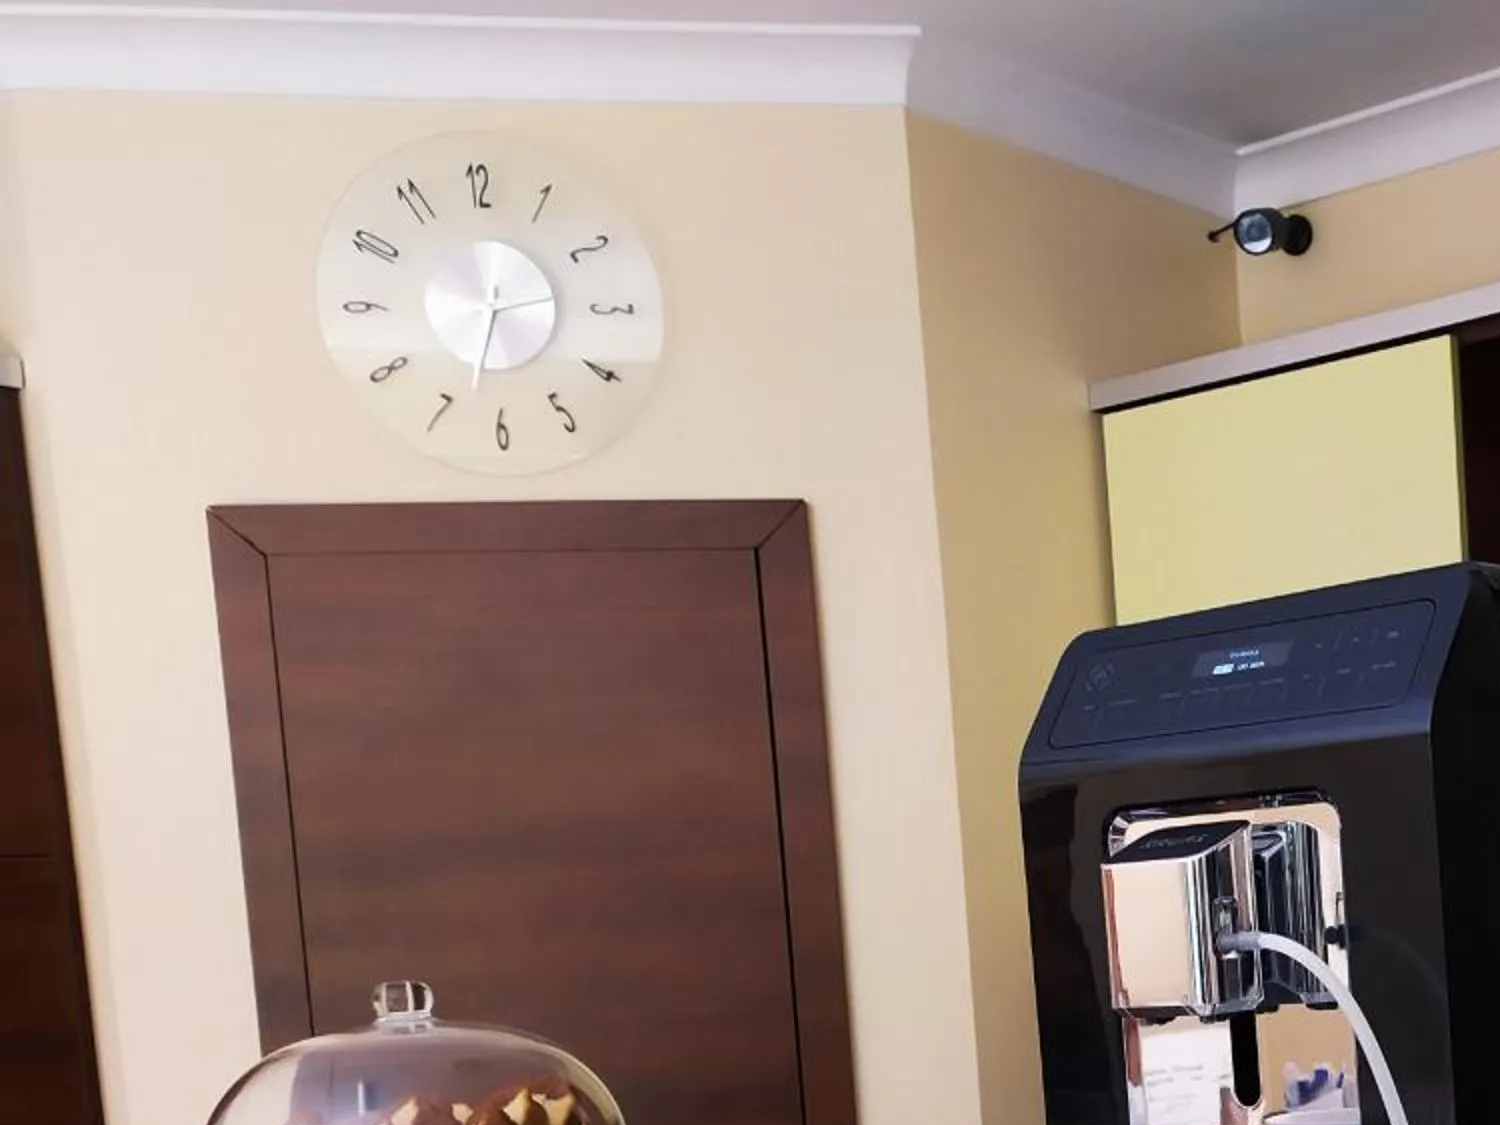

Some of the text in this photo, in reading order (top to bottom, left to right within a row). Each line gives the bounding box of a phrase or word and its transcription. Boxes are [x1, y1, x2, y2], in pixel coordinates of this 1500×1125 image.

[396, 178, 437, 225] 11
[465, 161, 492, 209] 12
[531, 183, 553, 223] 1
[352, 229, 399, 264] 10
[569, 235, 609, 263] 2
[342, 301, 390, 315] 9
[589, 303, 635, 316] 3
[369, 356, 408, 383] 8
[581, 357, 622, 382] 4
[427, 393, 454, 433] 7
[495, 407, 510, 451] 6
[547, 392, 577, 433] 5
